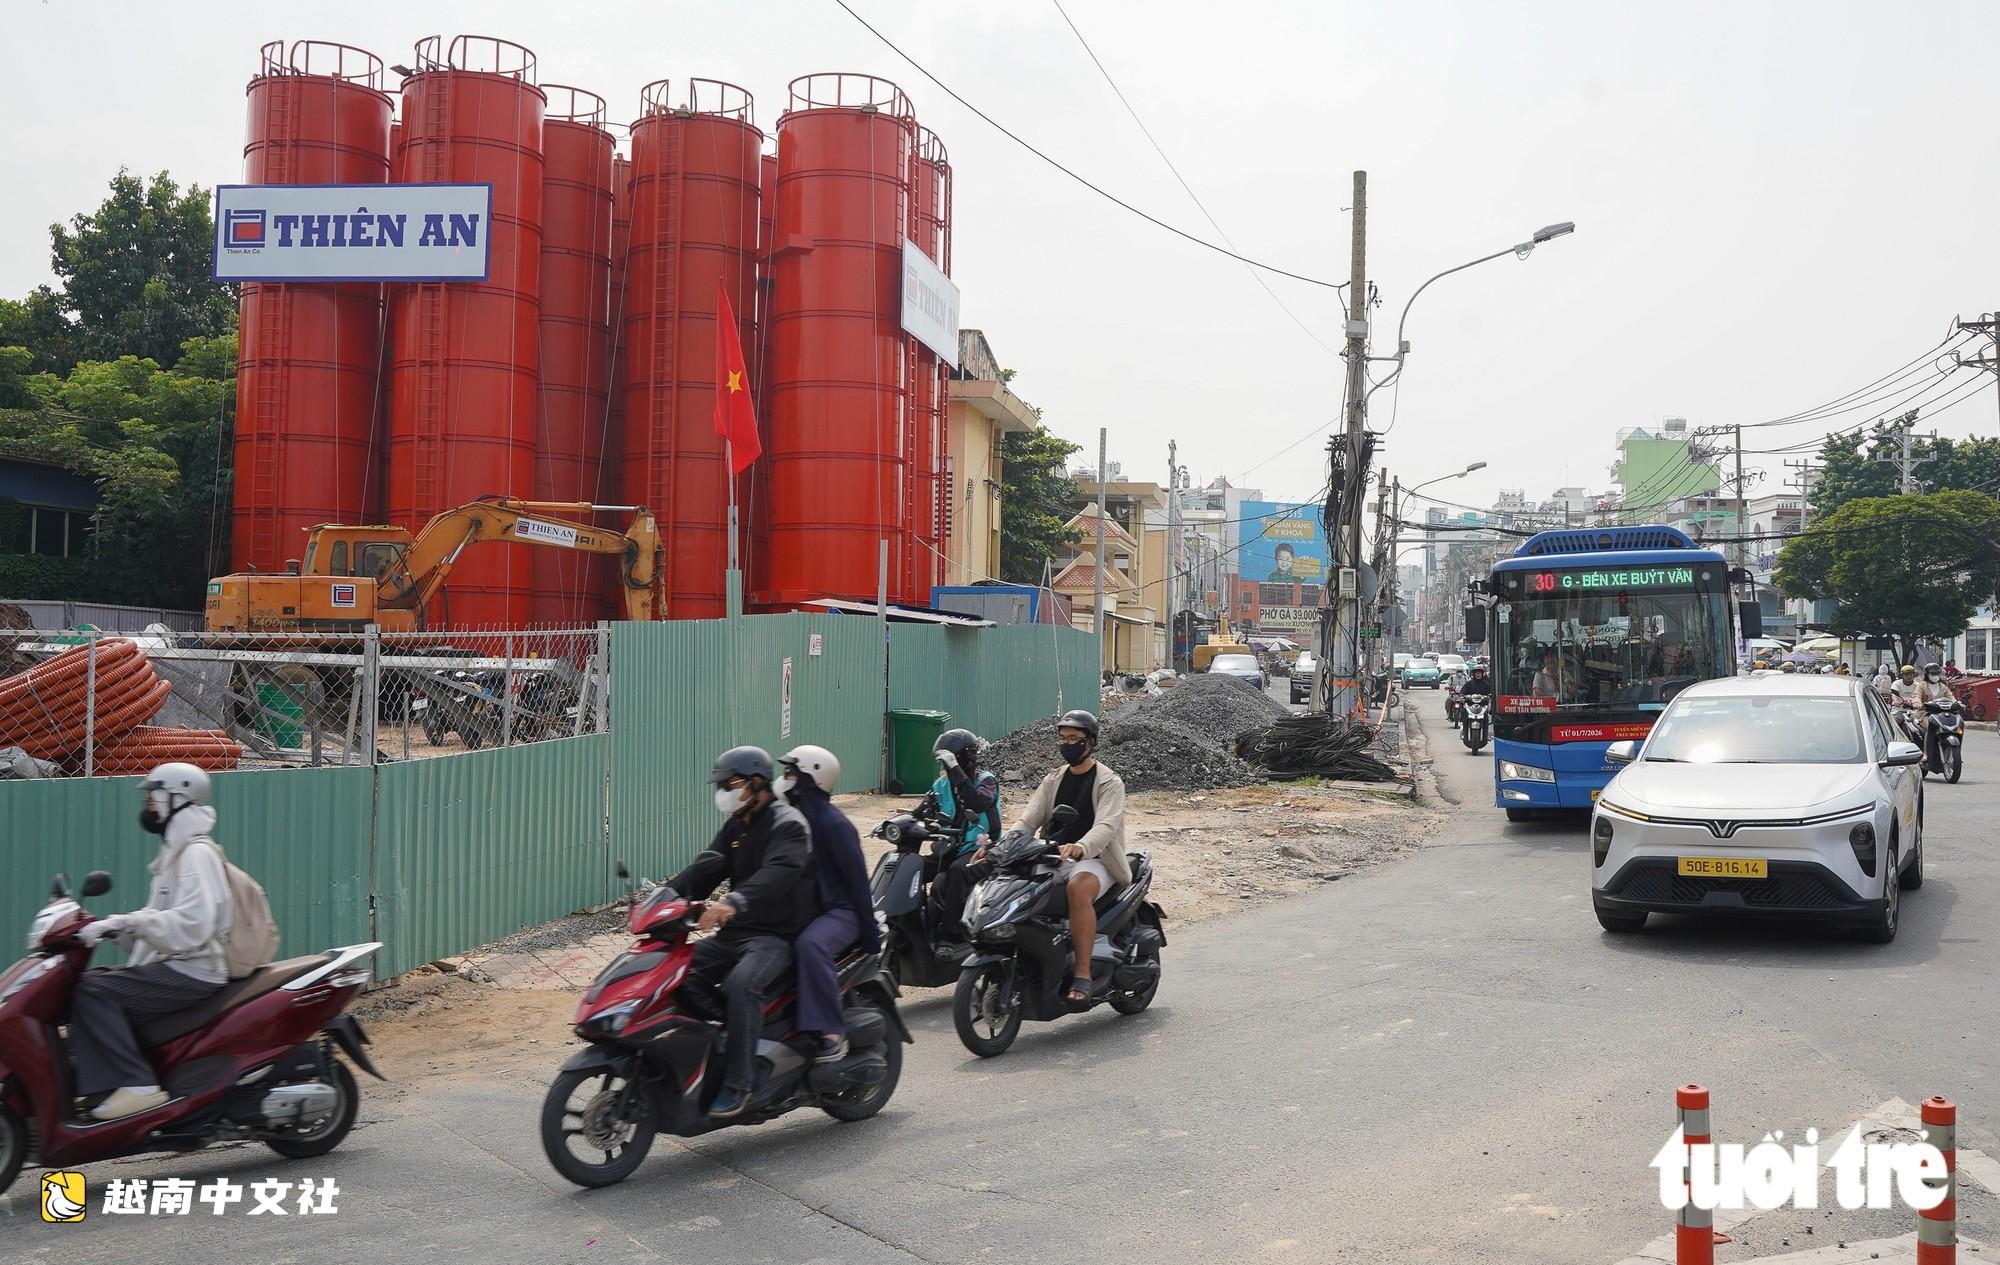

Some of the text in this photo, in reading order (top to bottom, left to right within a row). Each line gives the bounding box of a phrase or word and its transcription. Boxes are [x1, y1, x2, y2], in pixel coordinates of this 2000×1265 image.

[274, 206, 480, 248] THIÊN AN
[530, 523, 559, 536] THIEN
[560, 530, 575, 539] AN
[1535, 573, 1554, 591] 30
[1562, 578, 1572, 587] G
[1611, 574, 1628, 585] XE
[1631, 569, 1664, 584] BUÝT
[1669, 568, 1692, 583] VĂN
[1686, 861, 1759, 874] 50E-816.14
